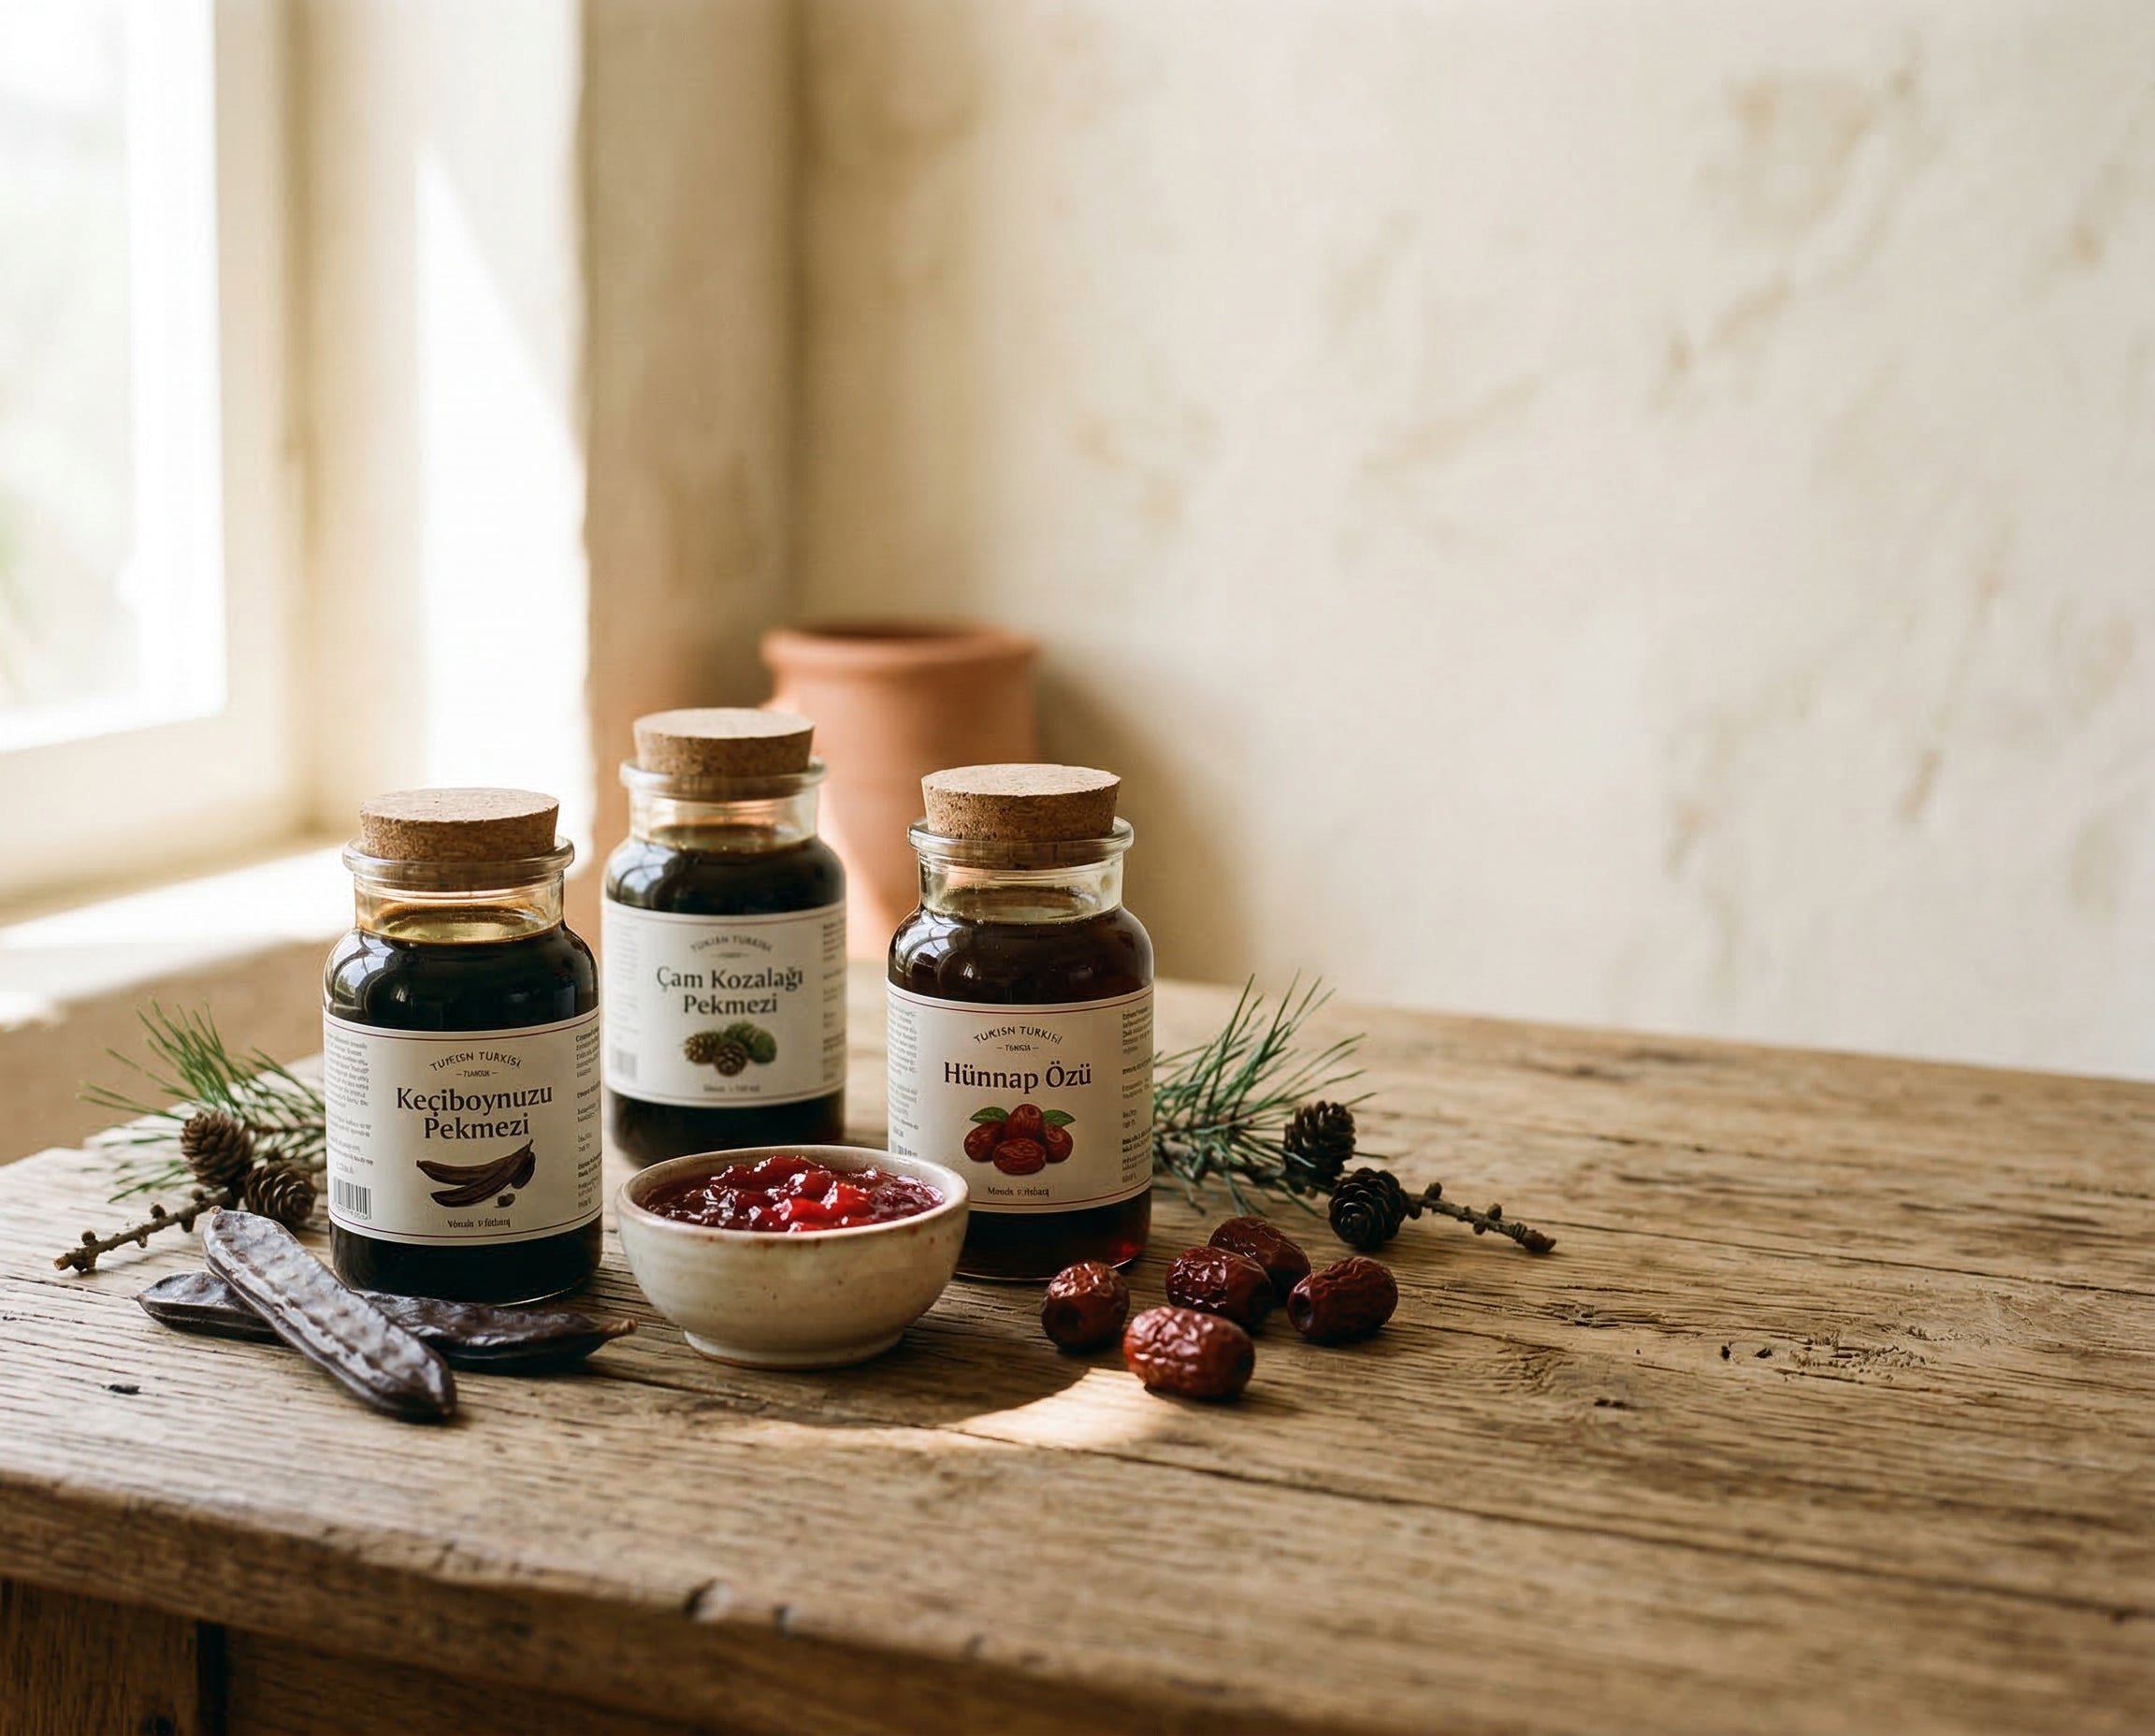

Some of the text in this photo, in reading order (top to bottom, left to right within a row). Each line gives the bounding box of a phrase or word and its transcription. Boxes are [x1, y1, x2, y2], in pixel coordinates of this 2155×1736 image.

[657, 966, 803, 991] Çam Kozalağı
[683, 992, 778, 1015] Pekmezi
[944, 1061, 1039, 1094] Hünnap
[1045, 1060, 1092, 1088] Özü
[396, 1086, 553, 1117] Keçiboynuzu
[424, 1112, 530, 1140] Pekmezi
